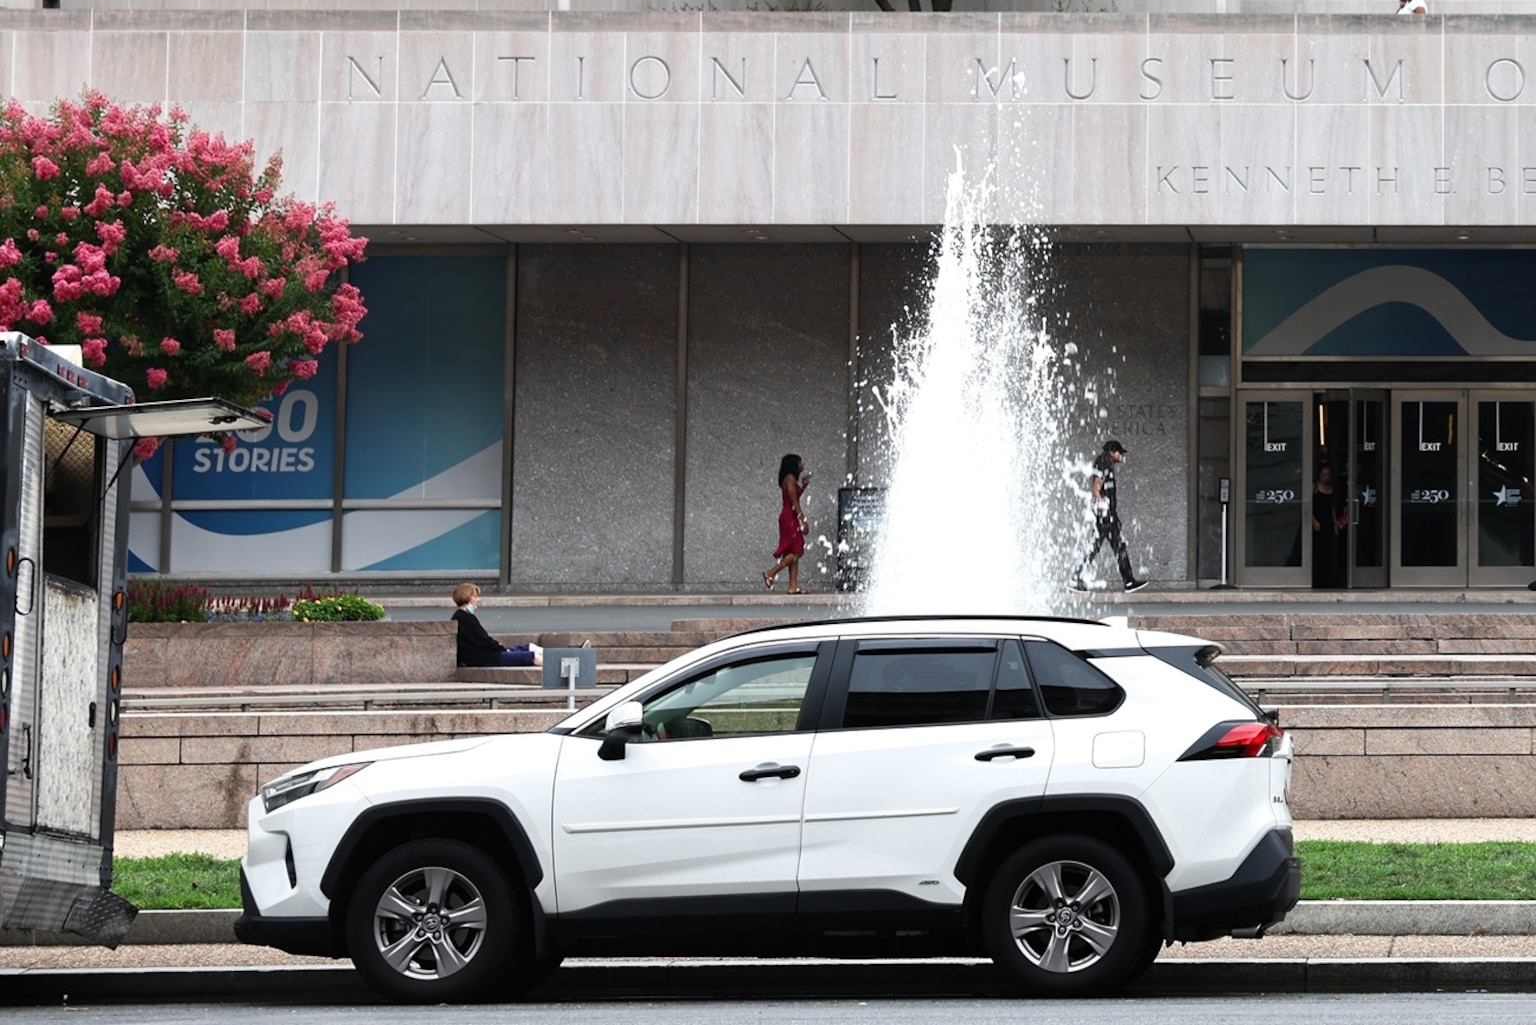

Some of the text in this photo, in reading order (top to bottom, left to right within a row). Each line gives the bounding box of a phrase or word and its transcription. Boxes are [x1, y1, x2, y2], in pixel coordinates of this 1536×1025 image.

[347, 56, 898, 101] NATIONAL
[973, 58, 1407, 102] MUSEUM
[1155, 166, 1400, 195] KENNETH
[1267, 442, 1287, 451] EXIT
[1364, 442, 1376, 451] EXIT
[1421, 442, 1442, 452] EXIT
[1499, 442, 1519, 451] EXIT
[193, 447, 315, 473] STORIES
[1266, 489, 1295, 504] 250
[1421, 489, 1450, 504] 250
